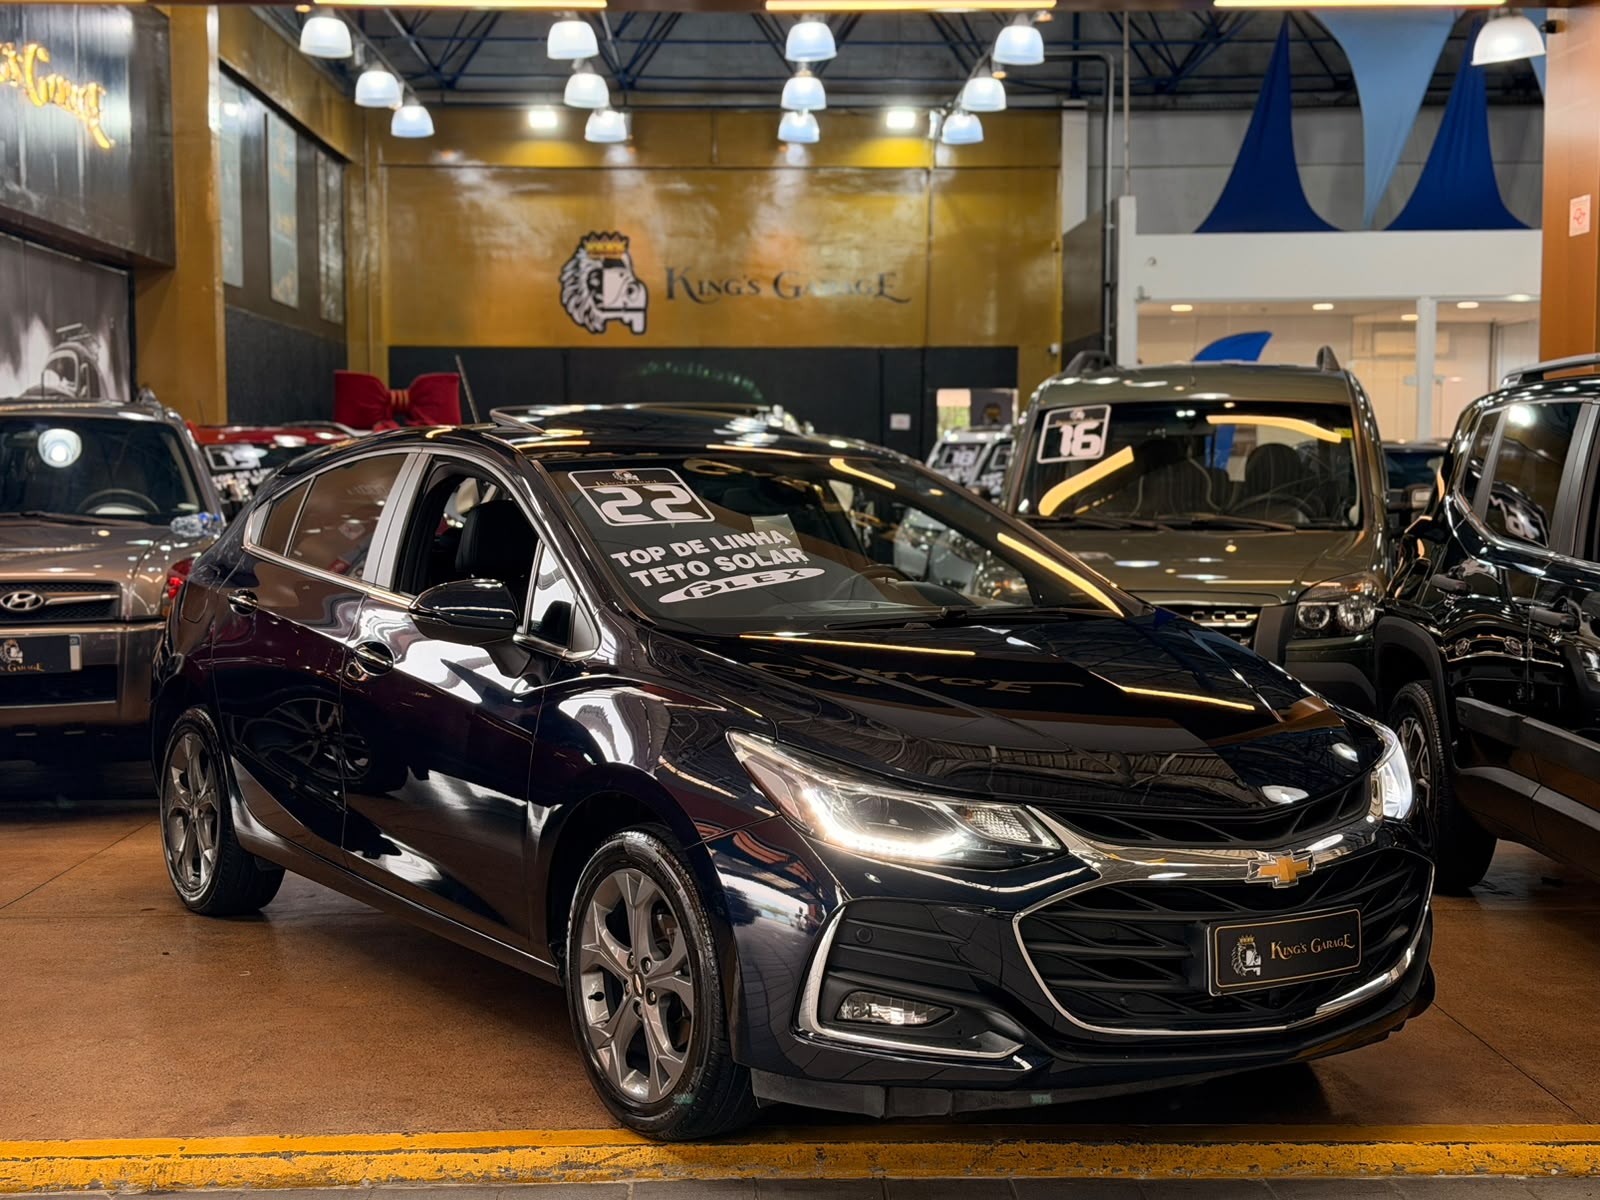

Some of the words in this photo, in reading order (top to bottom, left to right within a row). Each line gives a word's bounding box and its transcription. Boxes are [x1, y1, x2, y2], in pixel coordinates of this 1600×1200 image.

[665, 266, 760, 305] KING'S
[772, 270, 912, 305] GAAGE
[1059, 421, 1101, 457] 16
[594, 485, 704, 523] 22
[610, 546, 667, 568] TOP
[669, 538, 710, 558] DE
[708, 529, 791, 551] LINHA
[629, 560, 711, 587] TETO
[713, 547, 809, 572] SOLAR
[683, 569, 808, 599] FLEX
[1270, 940, 1308, 960] KING'S
[1310, 933, 1355, 954] GARAGE
